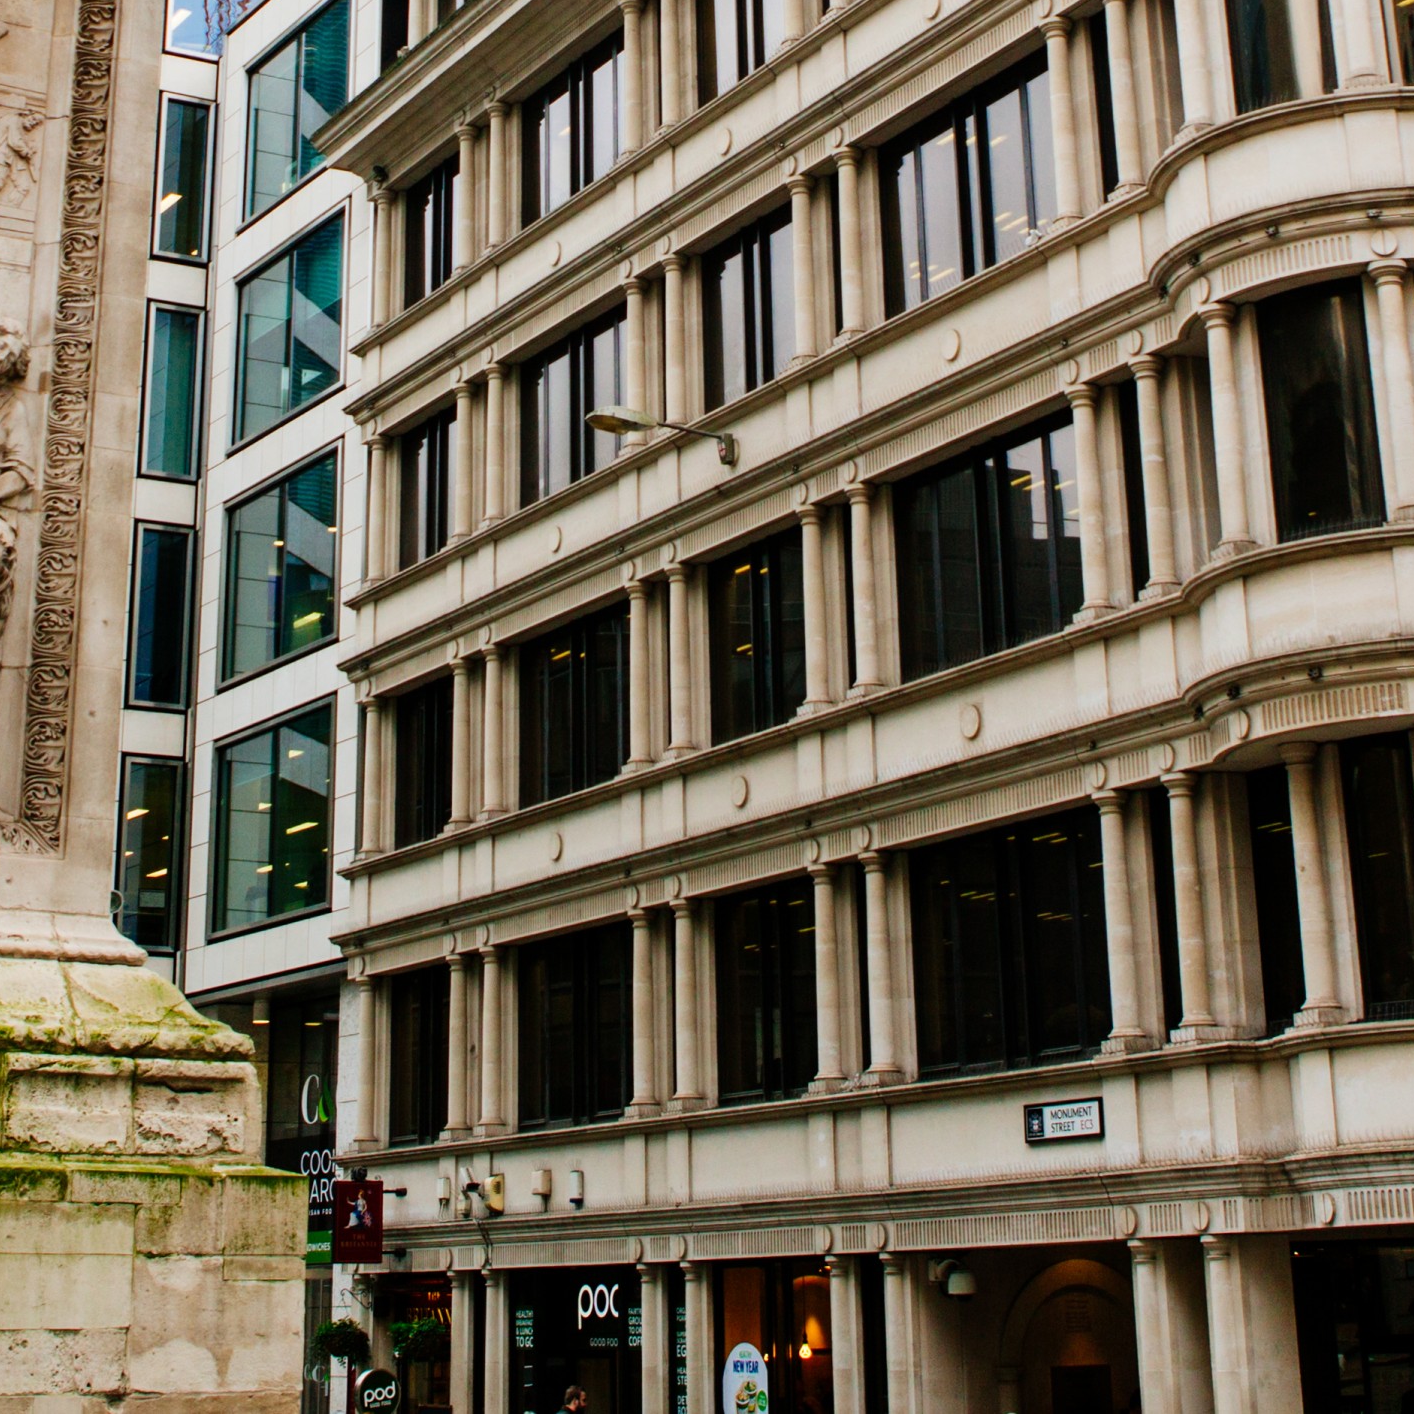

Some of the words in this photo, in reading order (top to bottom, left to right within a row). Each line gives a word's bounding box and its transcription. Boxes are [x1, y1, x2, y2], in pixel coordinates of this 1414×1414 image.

[1050, 1106, 1092, 1119] MONUMENT
[1051, 1120, 1075, 1133] STREET
[1080, 1119, 1094, 1131] EC3
[733, 1361, 744, 1373] NEW
[746, 1361, 759, 1373] YEAR
[364, 1381, 396, 1407] pod
